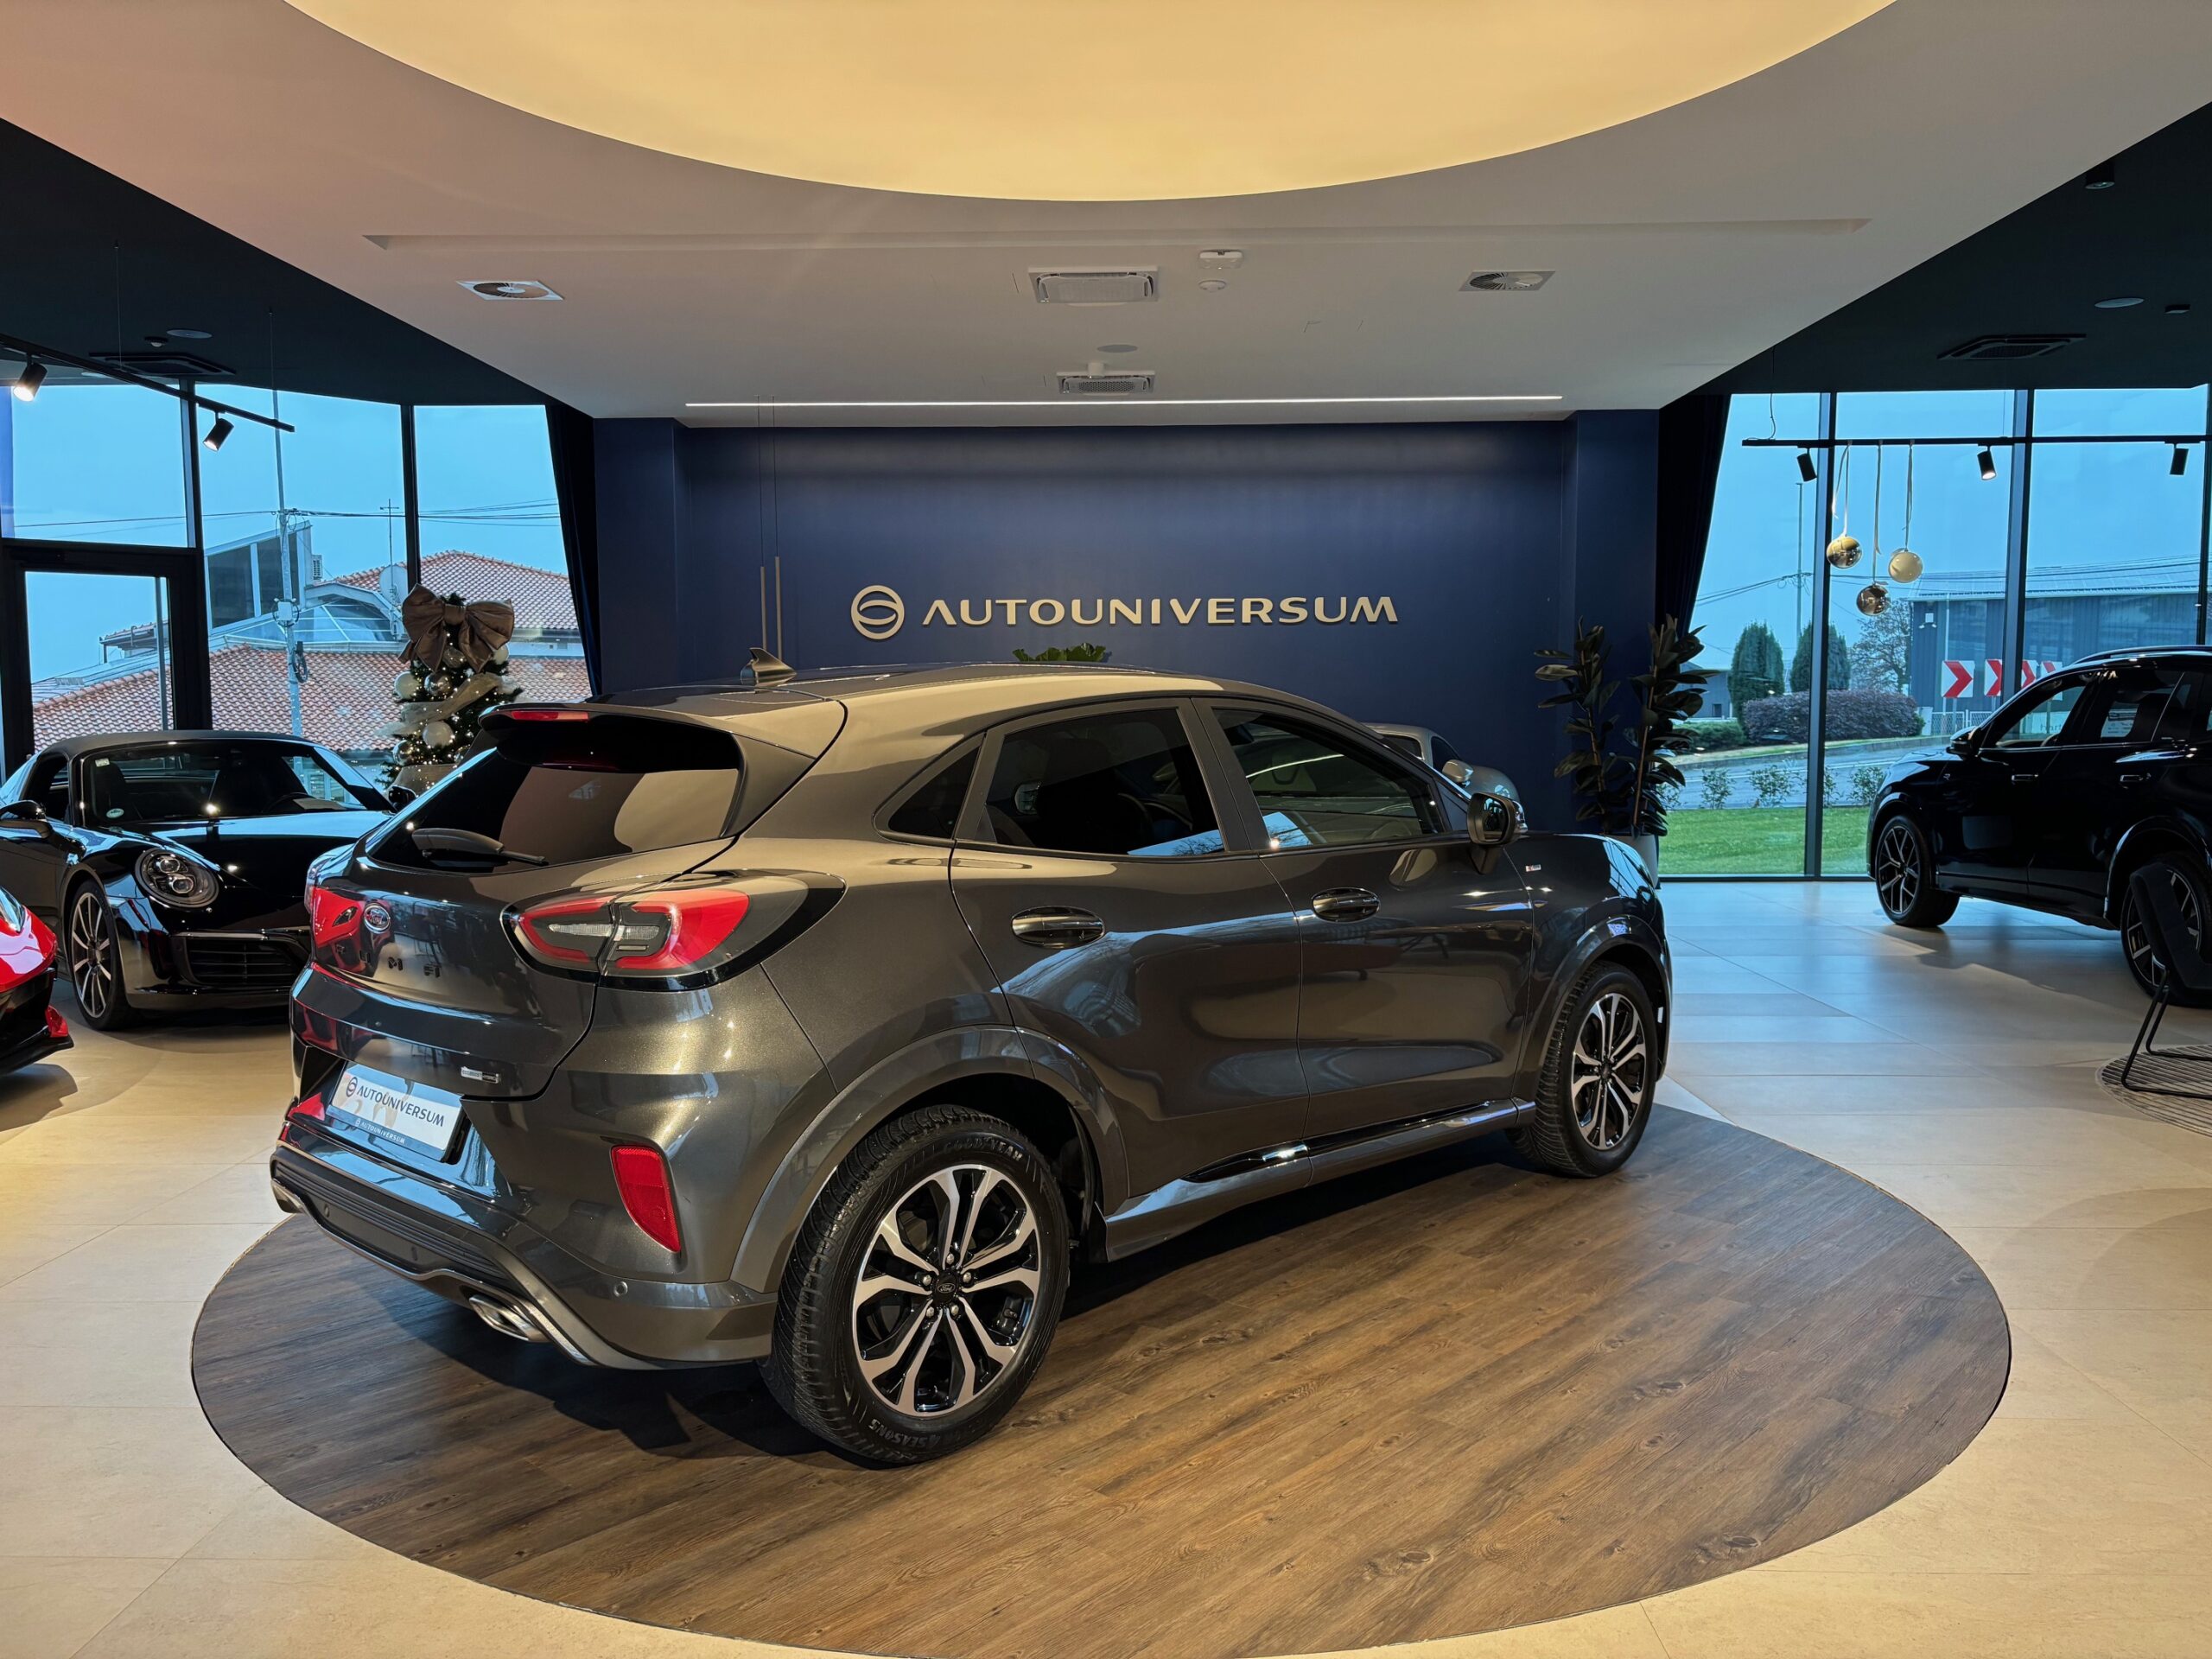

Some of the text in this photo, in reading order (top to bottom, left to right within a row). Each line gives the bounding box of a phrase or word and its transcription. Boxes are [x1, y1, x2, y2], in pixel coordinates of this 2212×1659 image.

[923, 596, 1399, 625] AUTOUNIVERSUM
[357, 1085, 444, 1127] AUTOUNIVERSUM
[360, 1122, 405, 1144] AUTOUNIVERSUM
